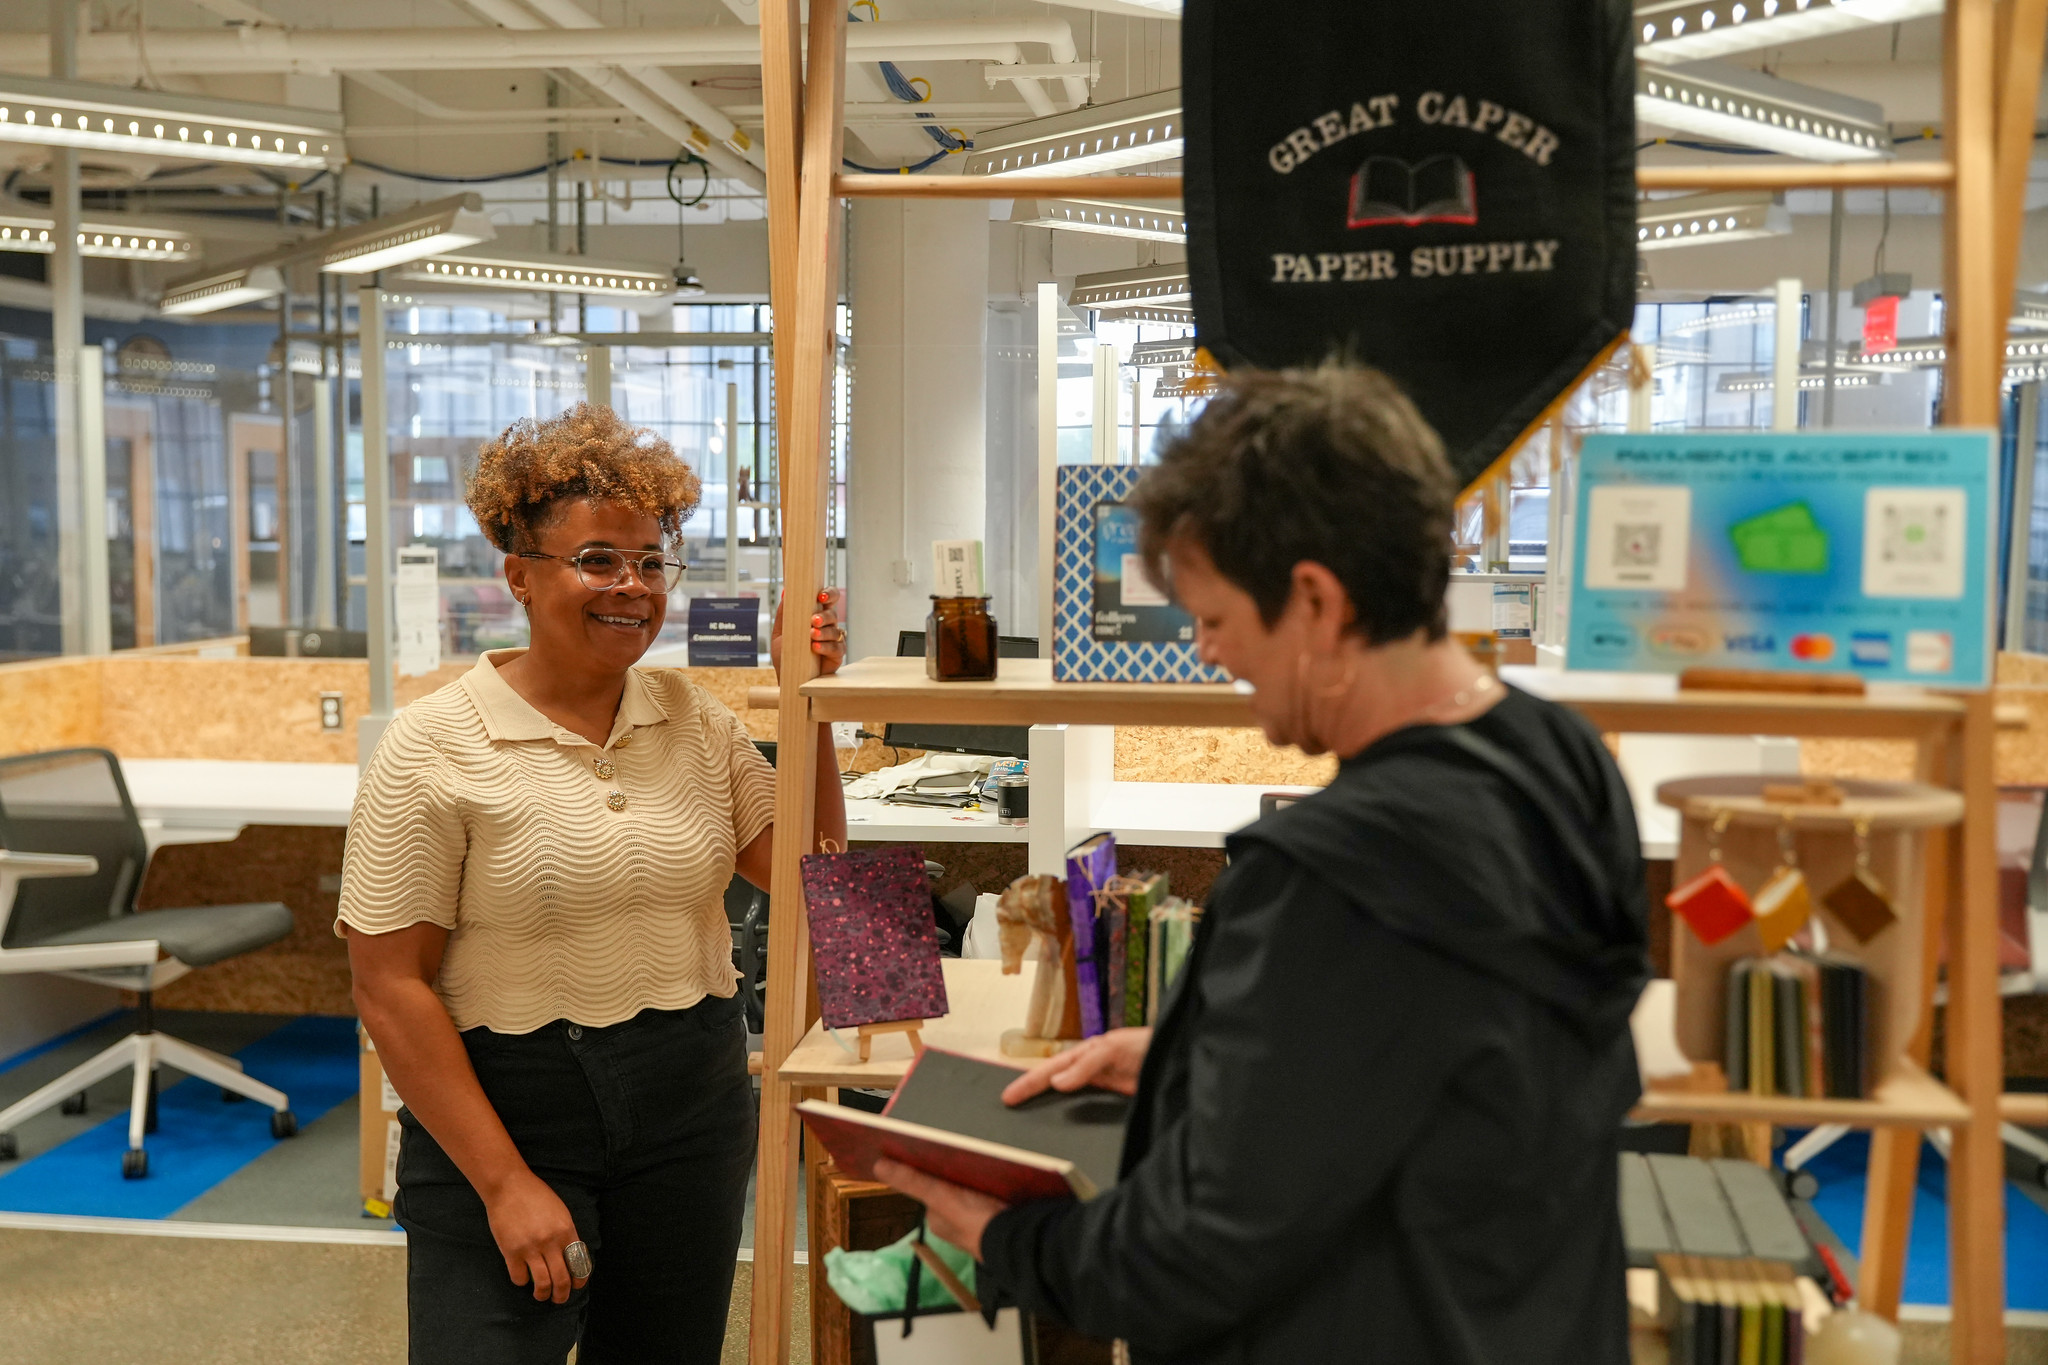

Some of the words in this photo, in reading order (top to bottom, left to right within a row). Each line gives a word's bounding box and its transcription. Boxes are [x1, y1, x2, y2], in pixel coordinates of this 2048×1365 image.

[1269, 94, 1399, 174] GREAT
[1416, 91, 1560, 167] CAPER
[1271, 250, 1398, 283] PAPER
[1410, 240, 1560, 278] SUPPLY
[1614, 447, 1775, 465] PAYMENTS
[1783, 450, 1950, 466] ACCEPTED
[1725, 634, 1776, 653] VISA
